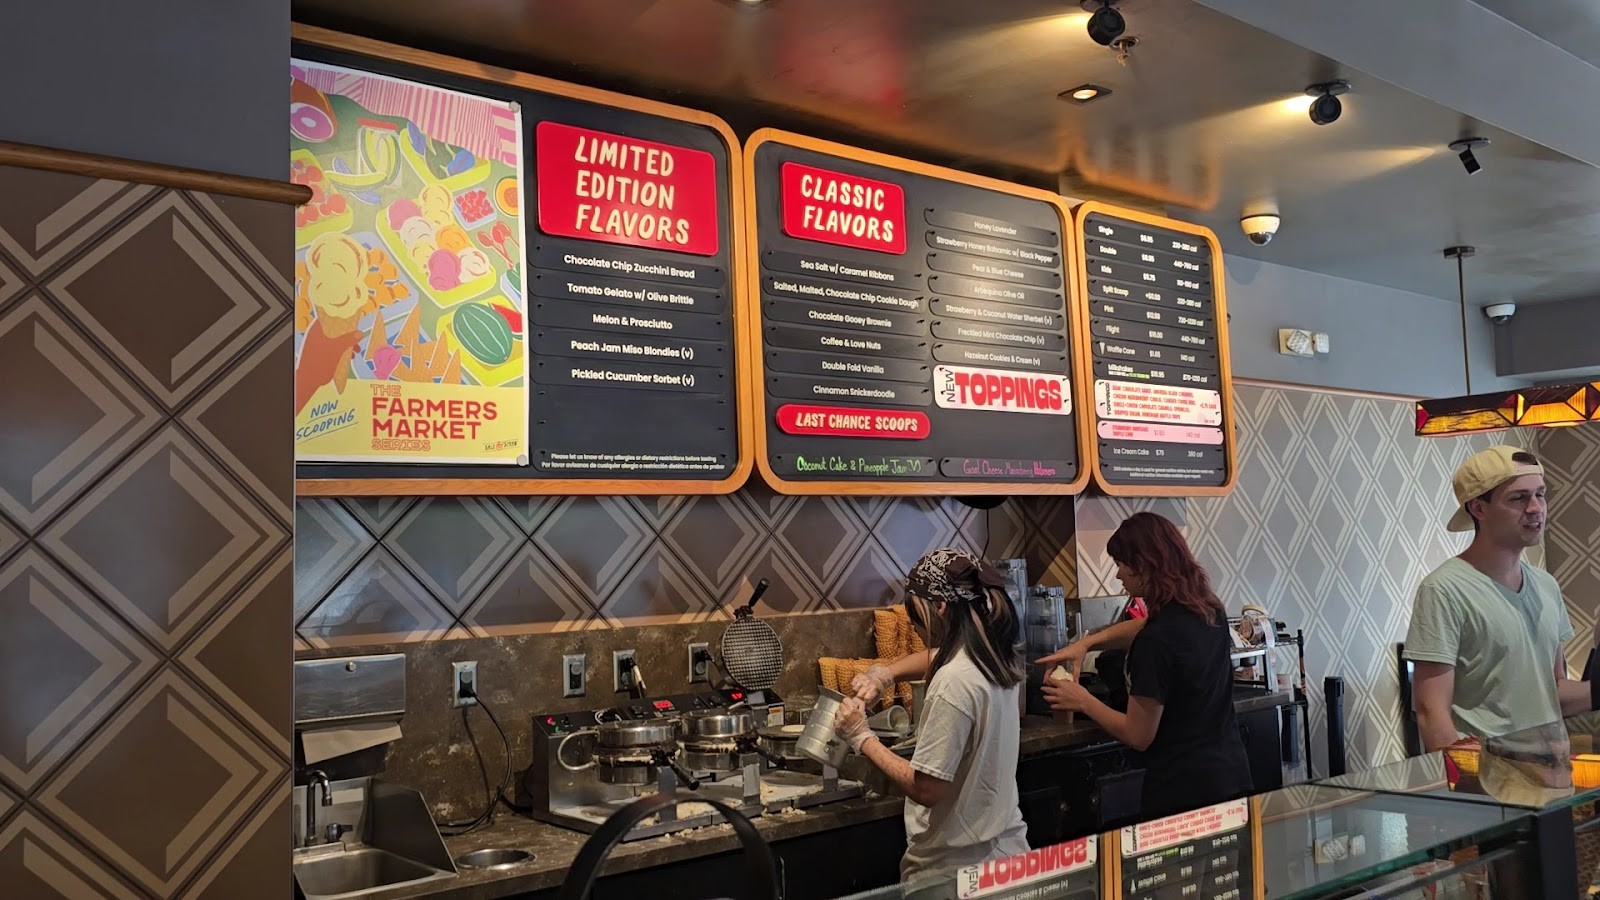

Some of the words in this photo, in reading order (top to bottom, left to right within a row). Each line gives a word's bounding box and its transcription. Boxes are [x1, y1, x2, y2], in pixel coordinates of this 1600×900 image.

[574, 135, 675, 177] LIMITED
[575, 169, 675, 211] EDITION
[801, 174, 885, 212] CLASSIC
[575, 203, 690, 245] FLAVORS
[802, 204, 894, 243] FLAVORS
[974, 221, 992, 232] Honey
[992, 224, 1017, 236] Lavender
[1098, 226, 1114, 236] Single
[936, 236, 968, 249] Strawberry
[968, 240, 986, 252] Honey
[986, 244, 1012, 256] Balsamic
[1020, 249, 1034, 260] Black
[1034, 253, 1053, 264] Pepper
[1100, 246, 1118, 256] Double
[564, 254, 610, 269] Chocolate
[612, 260, 632, 274] Chip
[634, 262, 670, 276] Zucchini
[670, 268, 695, 279] Bread
[800, 260, 814, 270] Sea
[814, 262, 829, 272] Salt
[830, 264, 838, 275] w/
[840, 266, 868, 277] Caramel
[869, 270, 894, 281] Ribbons
[972, 264, 986, 272] Pear
[986, 266, 991, 274] &
[991, 266, 1003, 276] Blue
[1004, 269, 1024, 278] Cheese
[1100, 265, 1112, 274] Kids
[567, 283, 602, 296] Tomato
[604, 287, 633, 298] Gelato
[634, 289, 646, 302] w/
[647, 292, 668, 303] Olive
[670, 294, 694, 305] Brittle
[774, 282, 798, 294] Salted,
[800, 285, 825, 297] Malted,
[826, 288, 860, 300] Chocolate
[860, 292, 875, 304] Chip
[876, 294, 898, 305] Cookie
[898, 298, 919, 309] Dough
[974, 286, 1003, 298] Arbequina
[1003, 289, 1016, 298] Olive
[1016, 291, 1024, 300] Oil
[1102, 285, 1114, 294] Split
[1114, 286, 1129, 298] Scoop
[946, 304, 977, 316] Strawberry
[978, 308, 982, 316] &
[983, 310, 1006, 319] Coconut
[1007, 312, 1024, 321] Water
[1024, 314, 1044, 324] Sherbet
[1104, 304, 1114, 314] Pint
[592, 314, 620, 326] Melon
[621, 316, 629, 326] &
[630, 317, 673, 330] Prosciutto
[808, 311, 844, 322] Chocolate
[844, 315, 866, 326] Gooey
[866, 317, 892, 328] Brownie
[958, 328, 982, 338] Freckled
[982, 330, 995, 339] Mint
[996, 332, 1023, 342] Chocolate
[1024, 334, 1036, 344] Chip
[1106, 324, 1120, 335] Flight
[570, 340, 600, 352] Peach
[600, 342, 621, 353] Jam
[622, 344, 643, 355] Miso
[644, 346, 680, 358] Blondies
[681, 348, 694, 360] (v)
[820, 336, 844, 347] Coffee
[844, 340, 850, 348] &
[850, 340, 866, 350] Love
[866, 342, 882, 350] Nuts
[1106, 345, 1122, 354] Waffle
[1122, 347, 1136, 356] Cone
[964, 351, 989, 360] Hazelnut
[990, 354, 1010, 363] Cookies
[1016, 356, 1032, 364] Cream
[822, 361, 846, 372] Double
[846, 363, 861, 372] Fold
[862, 364, 884, 374] Vanilla
[1108, 364, 1134, 372] Milkshakes
[572, 368, 604, 380] Pickled
[606, 370, 652, 384] Cucumber
[653, 374, 681, 385] Sorbet
[682, 374, 695, 387] (v)
[370, 383, 402, 397] THE
[813, 386, 850, 396] Cinnamon
[850, 388, 896, 399] Snickerdoodle
[945, 370, 956, 402] NEW
[954, 372, 1062, 410] TOPPINGS
[310, 399, 339, 418] NOW
[371, 397, 498, 421] FARMERS
[296, 408, 356, 441] SCOOPING
[371, 418, 482, 440] MARKET
[795, 412, 826, 428] LAST
[828, 414, 872, 430] CHANCE
[875, 416, 918, 432] SCOOPS
[371, 439, 431, 452] SERIES
[1121, 448, 1137, 456] Cream
[1138, 448, 1150, 456] Cake
[796, 456, 826, 471] Coconut
[829, 456, 848, 471] Cake
[850, 460, 856, 471] &
[858, 458, 889, 476] Pineapple
[982, 459, 1004, 475] Cheese
